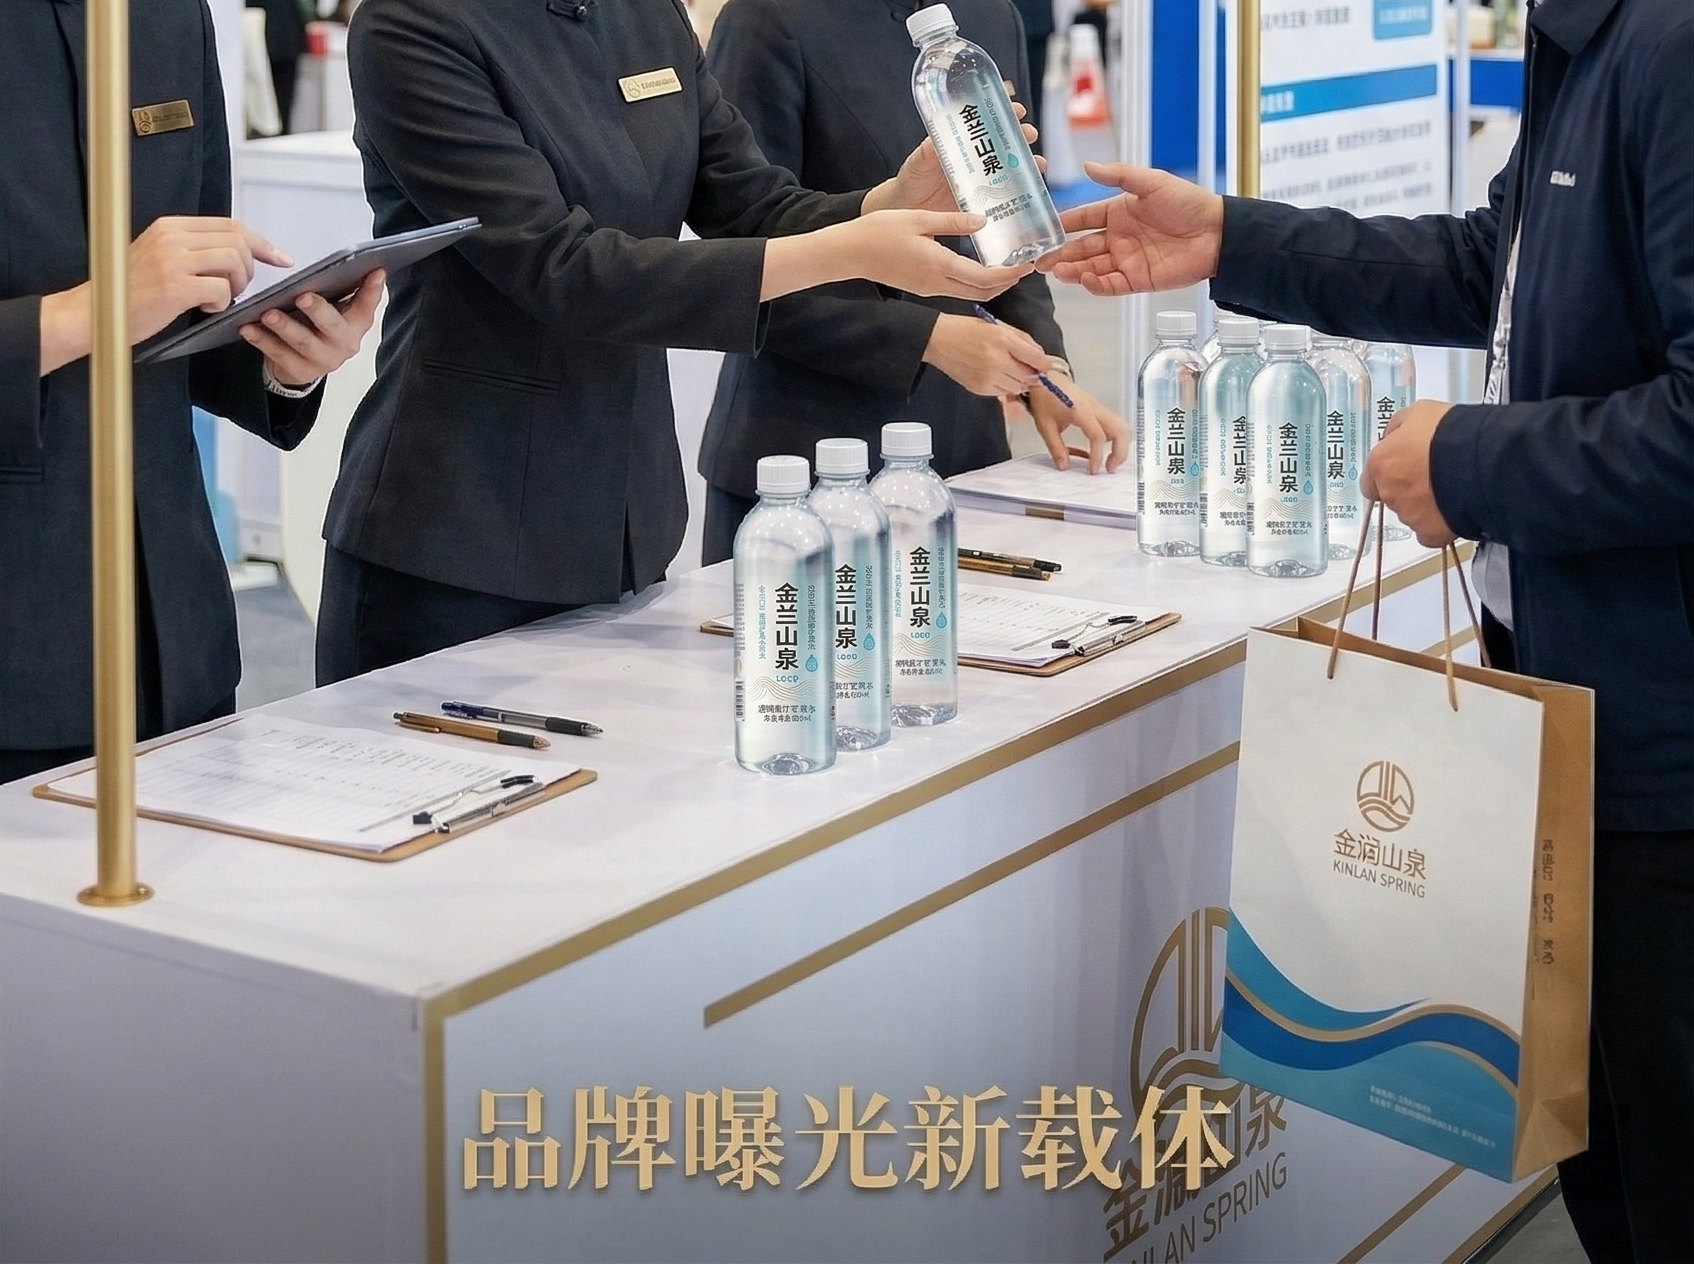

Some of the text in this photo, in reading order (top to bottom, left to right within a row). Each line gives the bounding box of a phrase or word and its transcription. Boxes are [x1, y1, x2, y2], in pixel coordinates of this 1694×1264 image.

[959, 104, 1004, 176] 金兰山泉
[1166, 407, 1186, 475] 金兰山泉
[1278, 422, 1299, 493] 金兰山泉
[1326, 410, 1345, 479] 金兰山泉
[834, 563, 858, 649] 金兰山泉
[909, 546, 931, 628] 金兰山泉
[774, 582, 799, 670] 金兰山泉
[1333, 859, 1426, 898] KINLAN SPRING
[1202, 1151, 1288, 1243] SPRING
